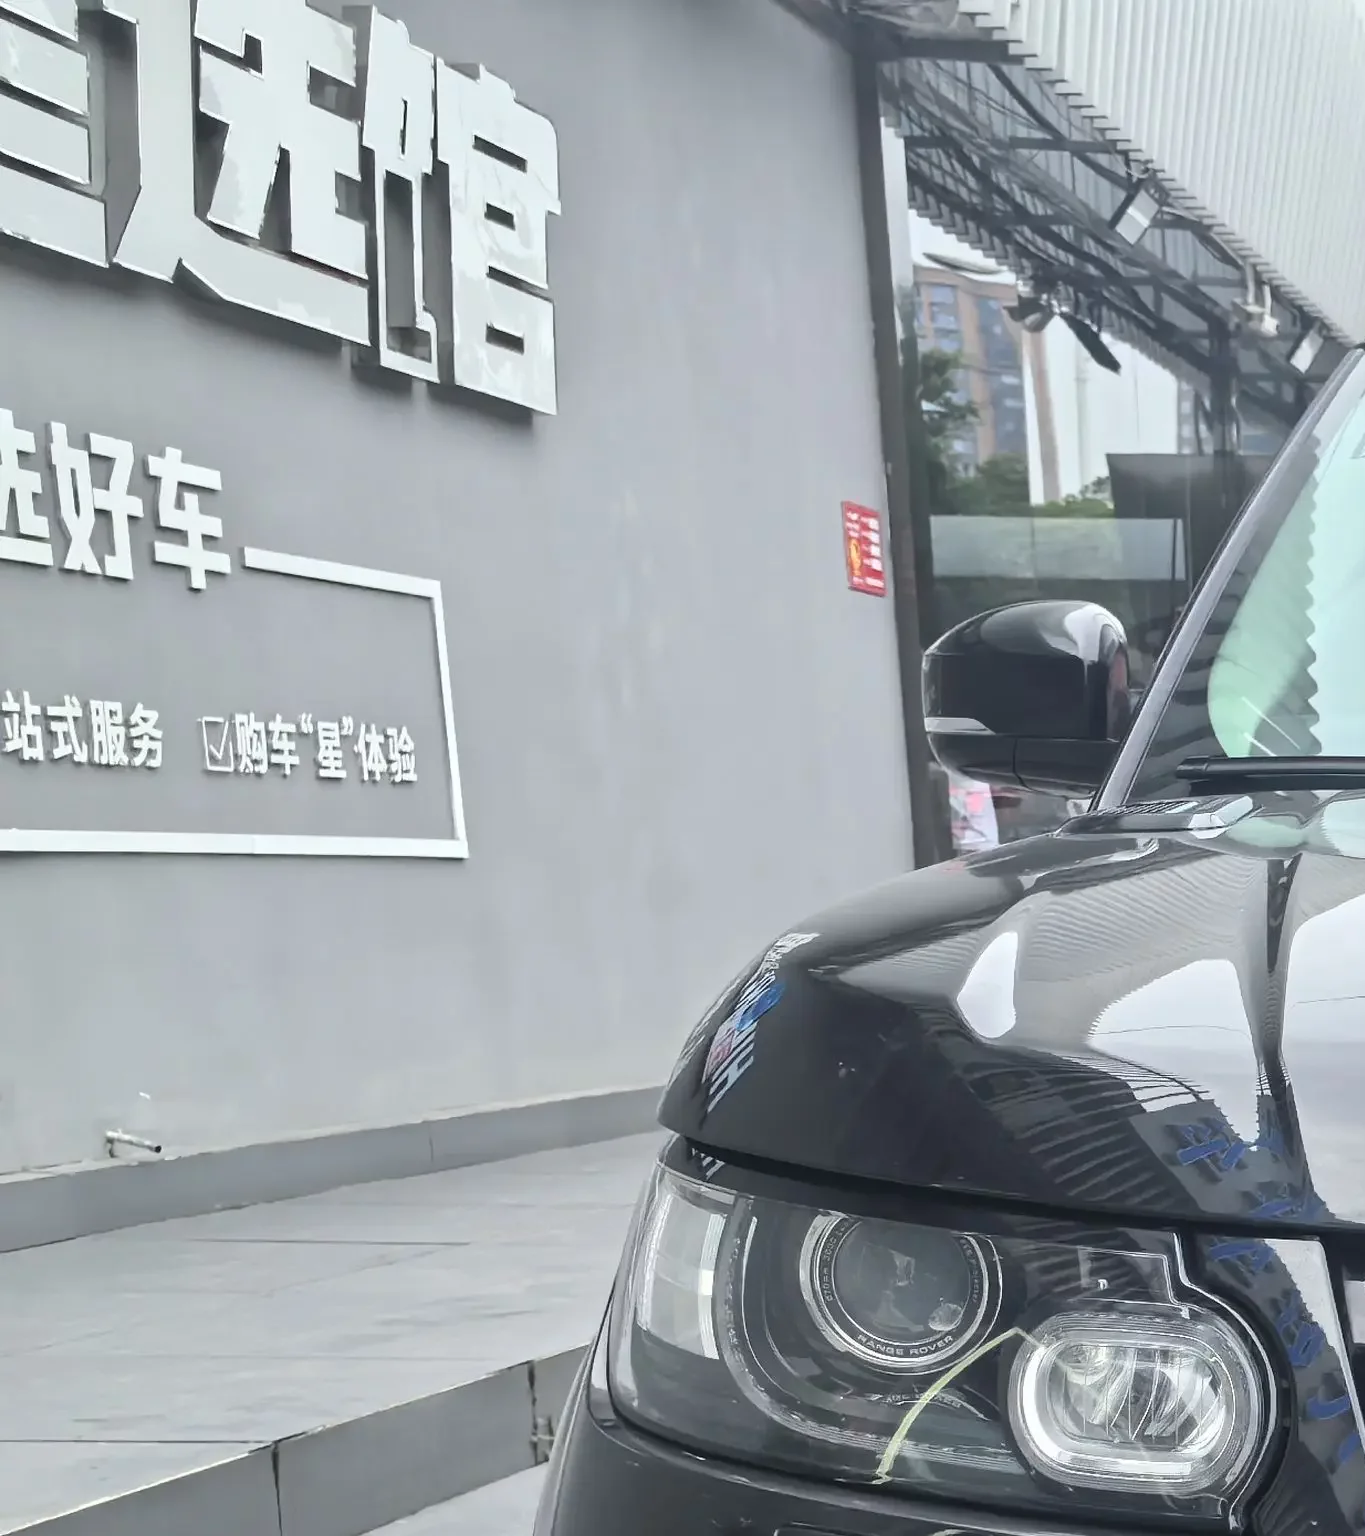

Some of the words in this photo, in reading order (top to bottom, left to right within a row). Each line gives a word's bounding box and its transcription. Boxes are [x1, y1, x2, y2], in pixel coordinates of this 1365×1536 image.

[0, 689, 163, 768] 站式服务
[856, 1333, 905, 1357] RANGE
[908, 1334, 955, 1357] ROVER
